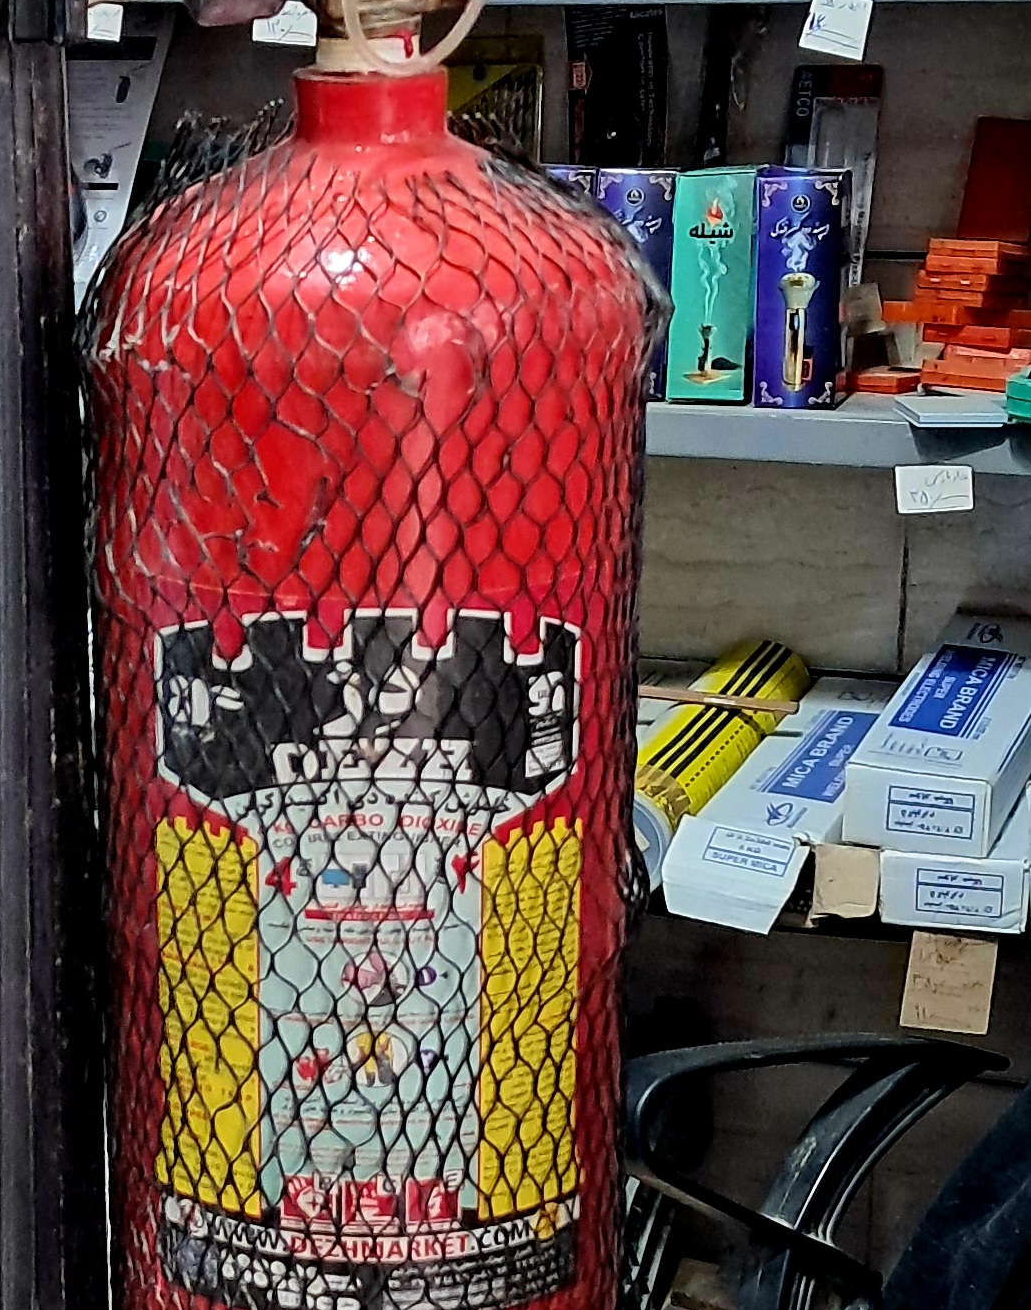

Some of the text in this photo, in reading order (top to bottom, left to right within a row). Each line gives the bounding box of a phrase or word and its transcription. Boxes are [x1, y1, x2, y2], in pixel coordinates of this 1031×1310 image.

[796, 69, 812, 118] AETCO
[965, 655, 997, 686] MICA
[939, 686, 979, 730] BRAND
[782, 716, 854, 790] MICA BRAND
[711, 851, 779, 874] SUPER MICA
